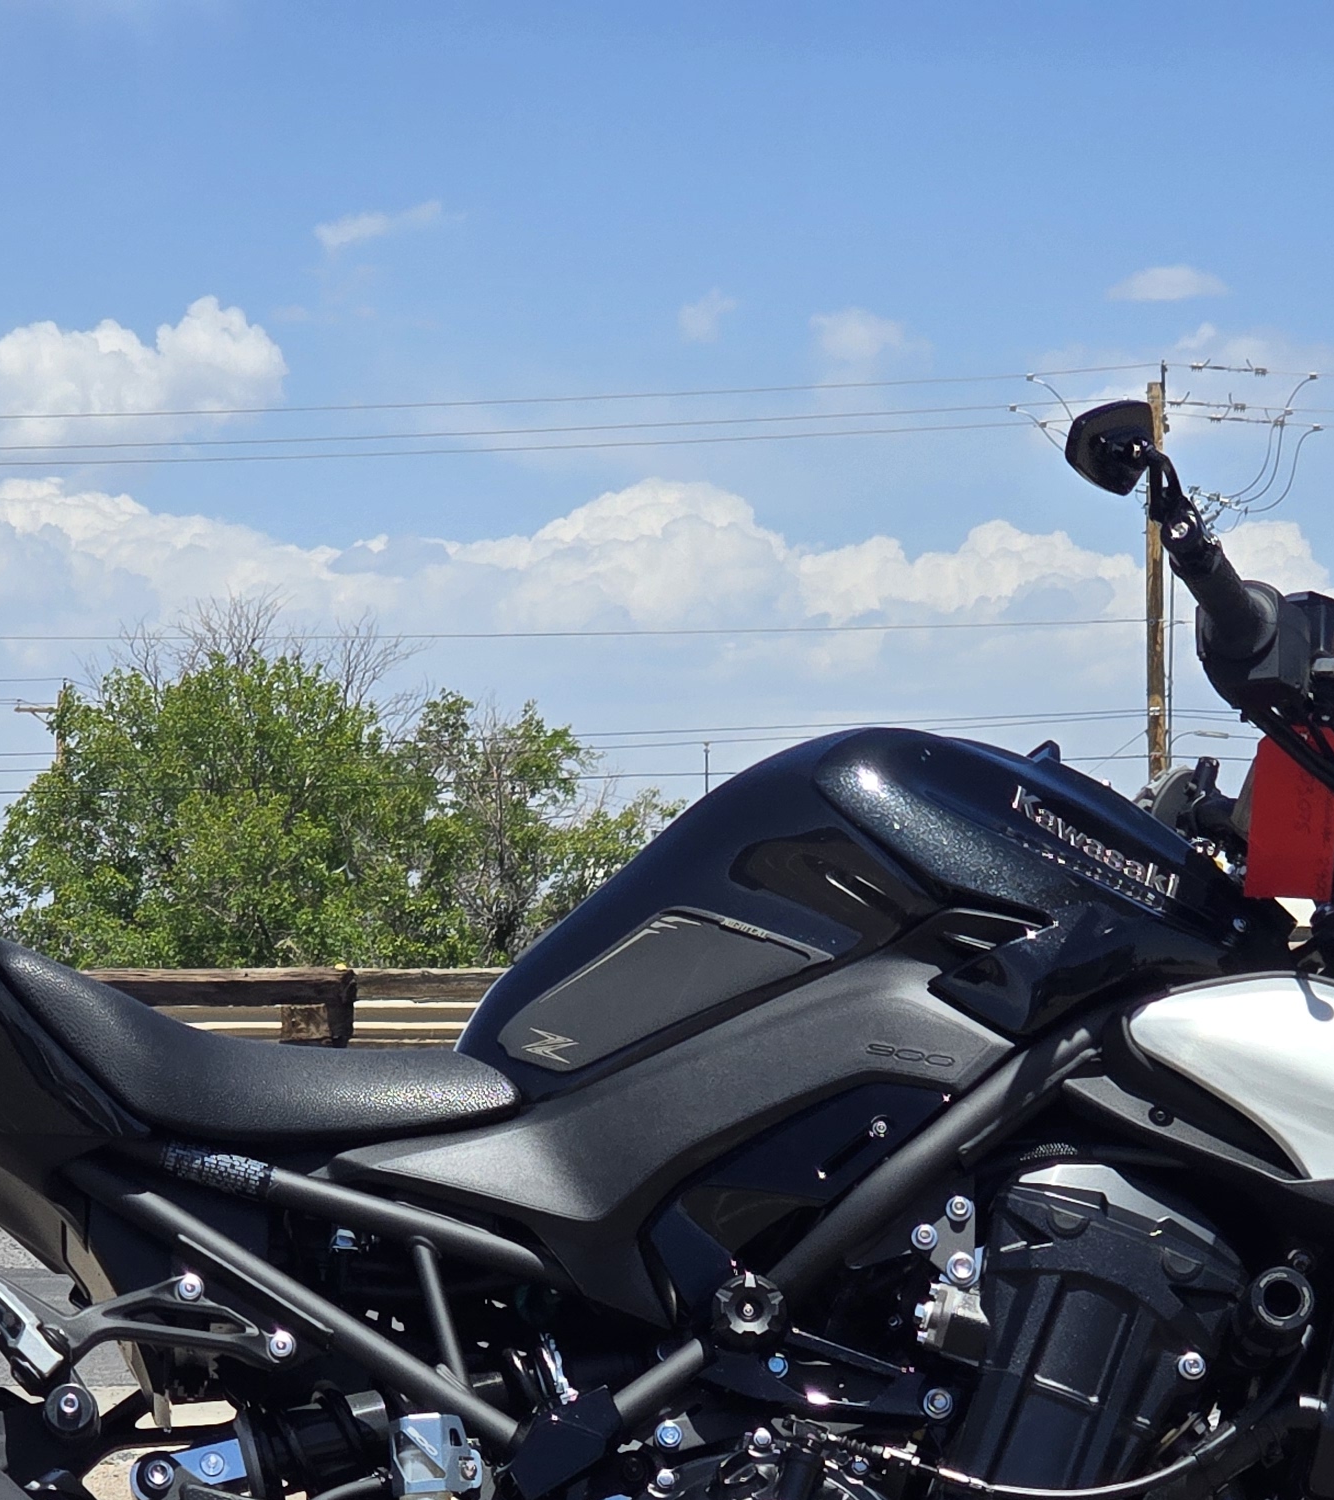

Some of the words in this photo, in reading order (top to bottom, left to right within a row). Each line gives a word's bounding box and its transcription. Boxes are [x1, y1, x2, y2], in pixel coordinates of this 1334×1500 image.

[1011, 784, 1180, 899] Kawasaki
[865, 1043, 956, 1067] 900
[406, 1424, 439, 1456] 900
